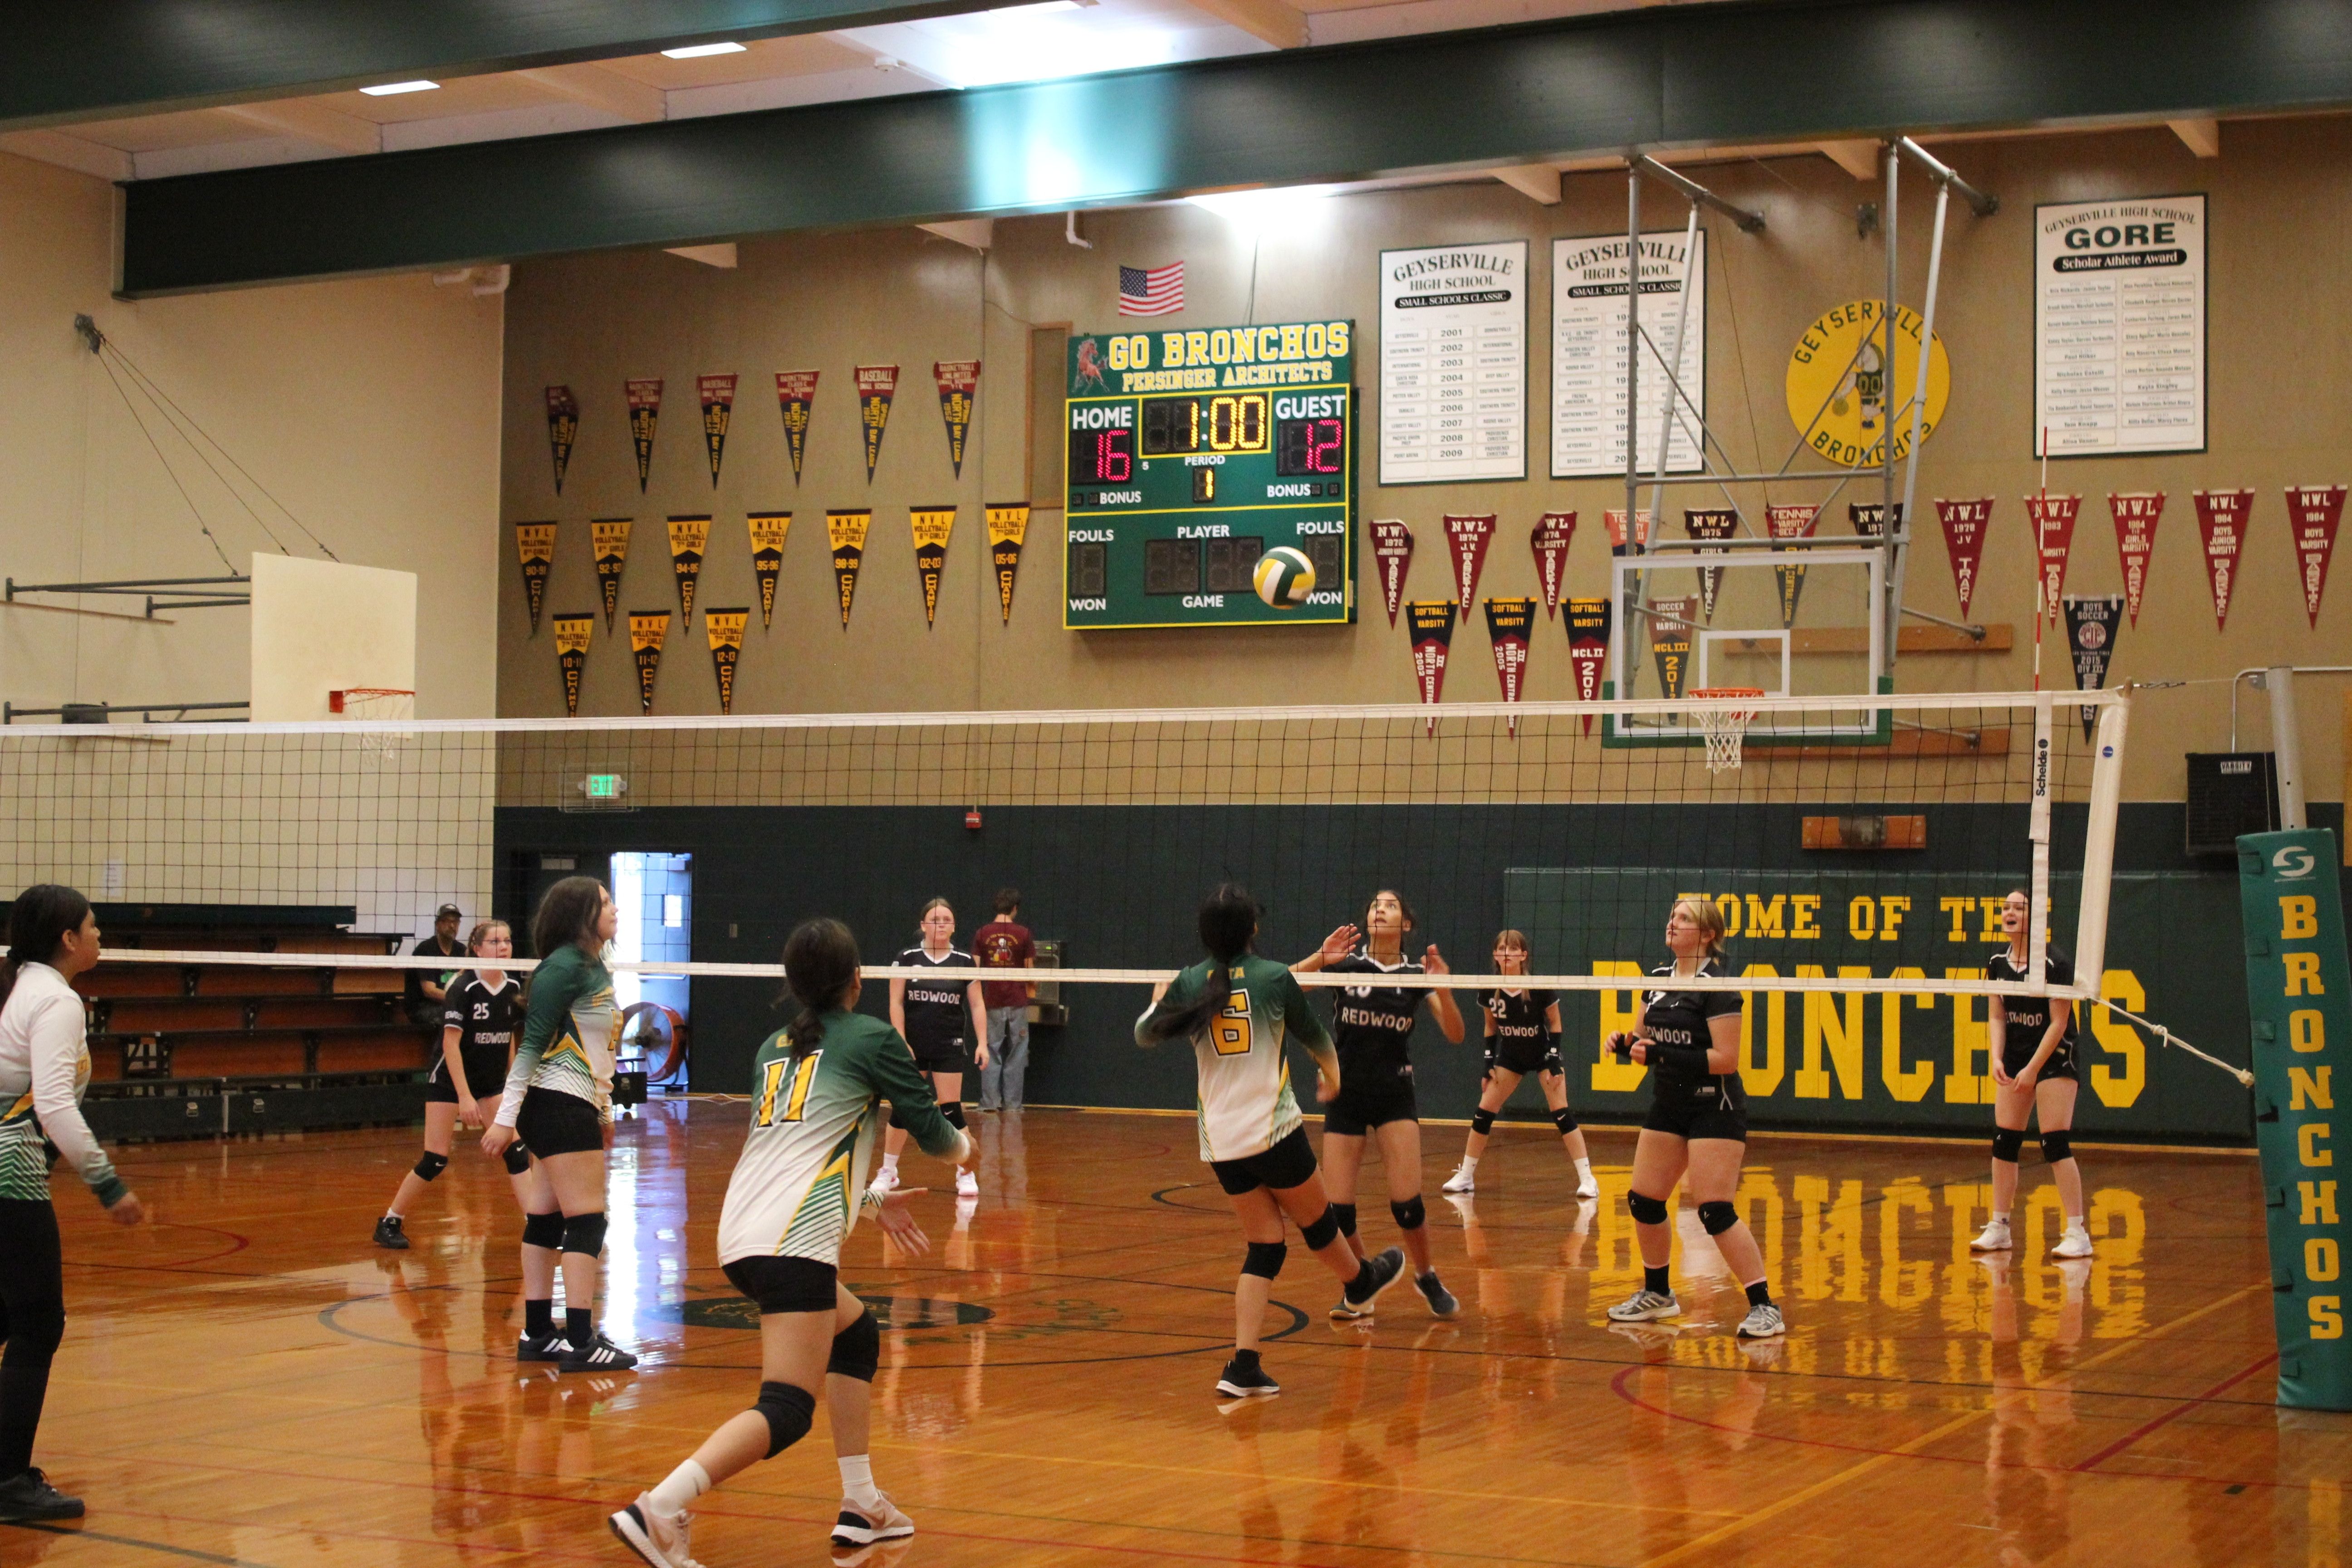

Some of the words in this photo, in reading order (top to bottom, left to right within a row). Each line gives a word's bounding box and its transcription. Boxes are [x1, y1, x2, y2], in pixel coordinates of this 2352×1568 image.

[2045, 207, 2117, 234] GEYSERVILLE
[2121, 206, 2148, 217] HIGH
[2152, 207, 2196, 225] SCHOOL
[2065, 222, 2175, 250] GORE
[2062, 255, 2102, 270] Scholar
[2105, 253, 2141, 267] Athlete
[2144, 251, 2177, 264] Award
[1394, 253, 1513, 282] GEYSERVILLE
[1583, 269, 1615, 280] HIGH
[1620, 264, 1673, 278] SHOOL
[1410, 279, 1441, 291] HIGH
[1445, 275, 1495, 289] SCHOOL
[1573, 288, 1601, 296] SMALL
[1399, 299, 1427, 307] SMALL
[1429, 294, 1469, 305] SCHOOLS
[1470, 293, 1506, 303] CLASSIC
[1108, 336, 1149, 370] GO
[1163, 322, 1349, 368] BRONCHOS
[859, 370, 892, 382] BASEBALL
[1122, 368, 1216, 392] PERSINGER
[1223, 362, 1333, 386] ARCHITECTS
[870, 397, 880, 426] NORTH
[951, 394, 962, 423] NORTH
[1276, 395, 1345, 419] GUEST
[1073, 407, 1132, 429] HOME
[1189, 395, 1265, 450] 1:00
[1306, 419, 1342, 472] 12
[1097, 430, 1130, 482] 16
[1185, 456, 1225, 466] PERIOD
[1205, 469, 1213, 497] 1
[1100, 491, 1142, 504] BONUS
[1267, 485, 1310, 497] BONUS
[2210, 496, 2238, 510] NWL
[2302, 493, 2330, 506] NWL
[1771, 510, 1813, 519] TENNIS
[2117, 500, 2156, 516] NWL
[1297, 521, 1344, 534] FOULS
[1452, 521, 1486, 532] NWL
[1693, 516, 1729, 527] NWL
[1069, 529, 1114, 542] FOULS
[1177, 525, 1230, 538] PLAYER
[2214, 526, 2232, 535] BOYS
[2305, 528, 2323, 538] BOYS
[2125, 534, 2146, 543] GIRLS
[2210, 535, 2236, 545] JUNIOR
[2300, 539, 2328, 549] VARSITY
[2122, 543, 2149, 552] VARSITY
[2209, 545, 2236, 555] VARSITY
[835, 559, 858, 568] 98-99
[920, 558, 941, 568] 02-03
[996, 554, 1016, 564] 05-06
[1070, 599, 1106, 610] WON
[1182, 596, 1224, 608] GAME
[1306, 592, 1342, 604] WON
[1415, 608, 1448, 616] SOFTBALL
[2083, 603, 2102, 611] BOYS
[1496, 617, 1524, 626] VARSITY
[2078, 612, 2108, 620] SOCCER
[1417, 620, 1445, 628] VARSITY
[1573, 619, 1603, 627] VARSITY
[718, 652, 735, 662] 12-13
[1425, 646, 1436, 675] NORTH
[1495, 646, 1505, 670] 2005
[1505, 643, 1517, 672] NORTH
[1415, 652, 1425, 676] 2002
[2036, 750, 2047, 796] Schelde
[591, 776, 613, 796] EXIT
[1678, 893, 1821, 940] OME
[1849, 895, 1911, 941] OF
[908, 990, 960, 1004] REDWOOD
[473, 1003, 489, 1019] 25
[1489, 998, 1507, 1019] 22
[1209, 988, 1253, 1058] 6
[1342, 1007, 1413, 1032] REDWOOD
[475, 1032, 510, 1044] REDWOOD
[754, 1049, 824, 1130] 11
[2278, 895, 2343, 1339] BRONCHOS
